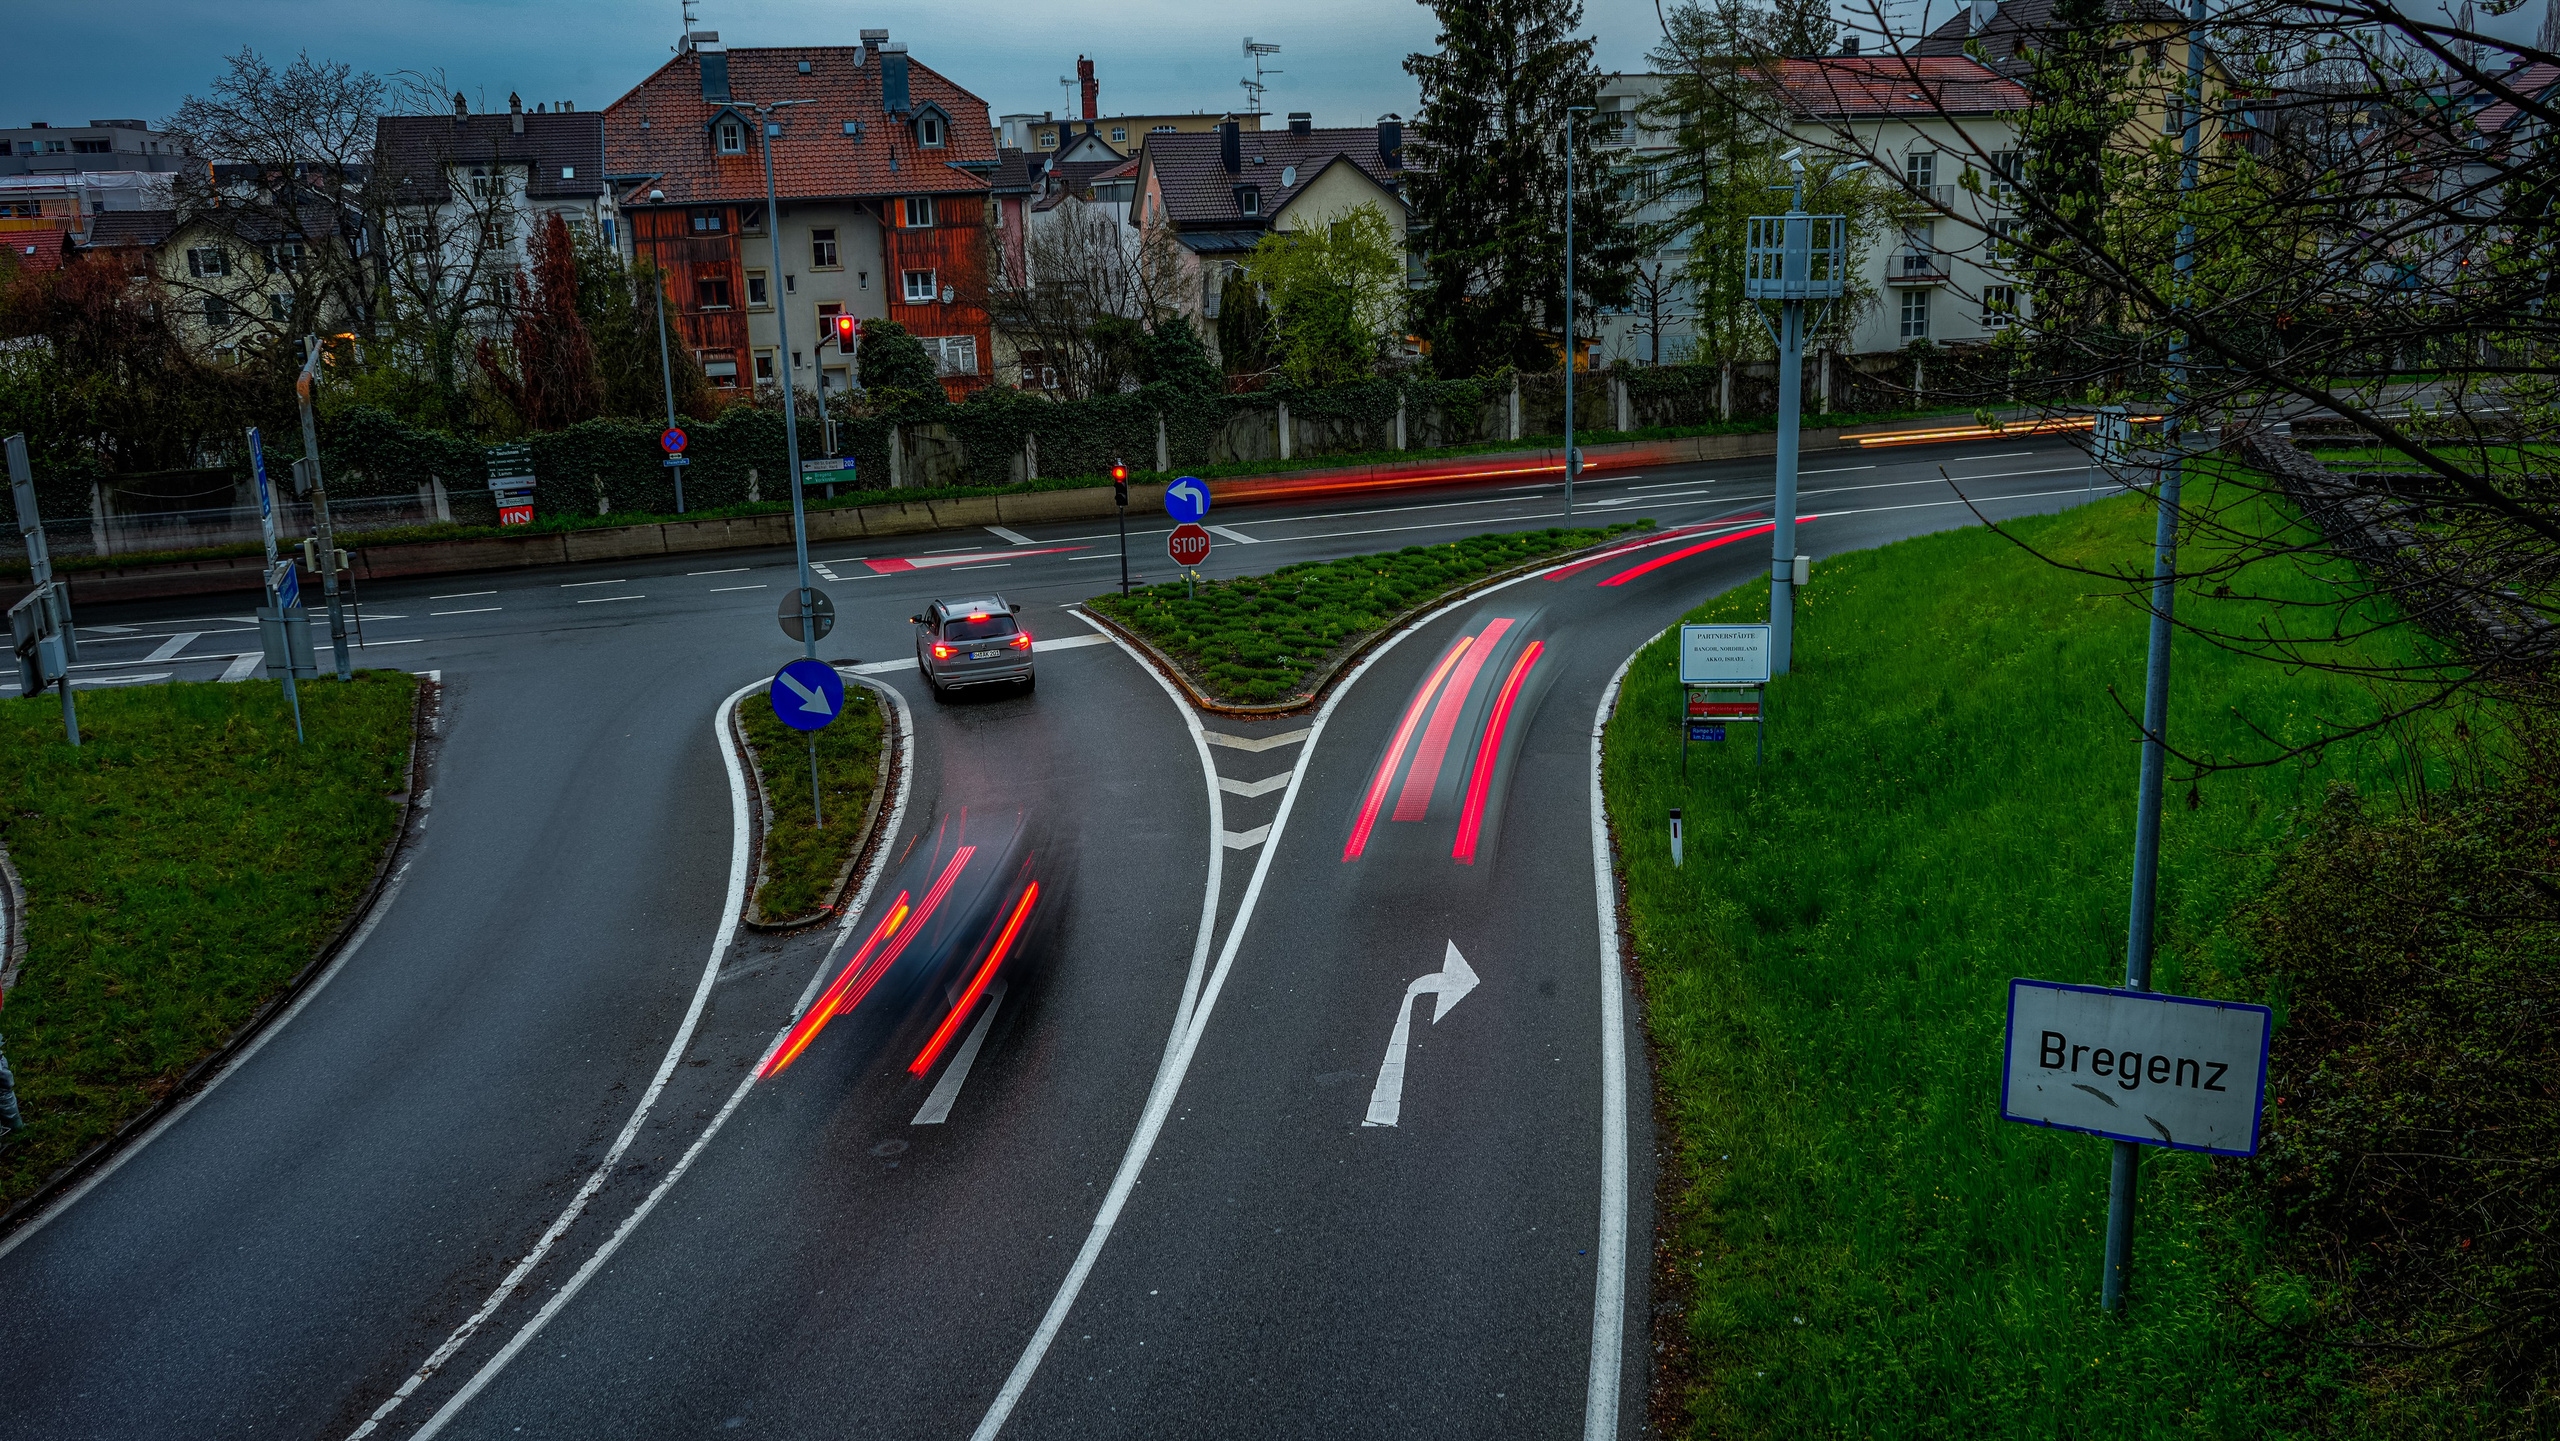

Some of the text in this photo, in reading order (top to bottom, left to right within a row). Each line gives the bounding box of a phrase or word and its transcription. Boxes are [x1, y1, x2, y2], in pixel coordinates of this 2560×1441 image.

[844, 459, 855, 467] 202
[1172, 536, 1206, 554] STOP
[1697, 632, 1756, 640] PARTNERSTÄDTE
[2039, 1030, 2229, 1092] Bregenz
